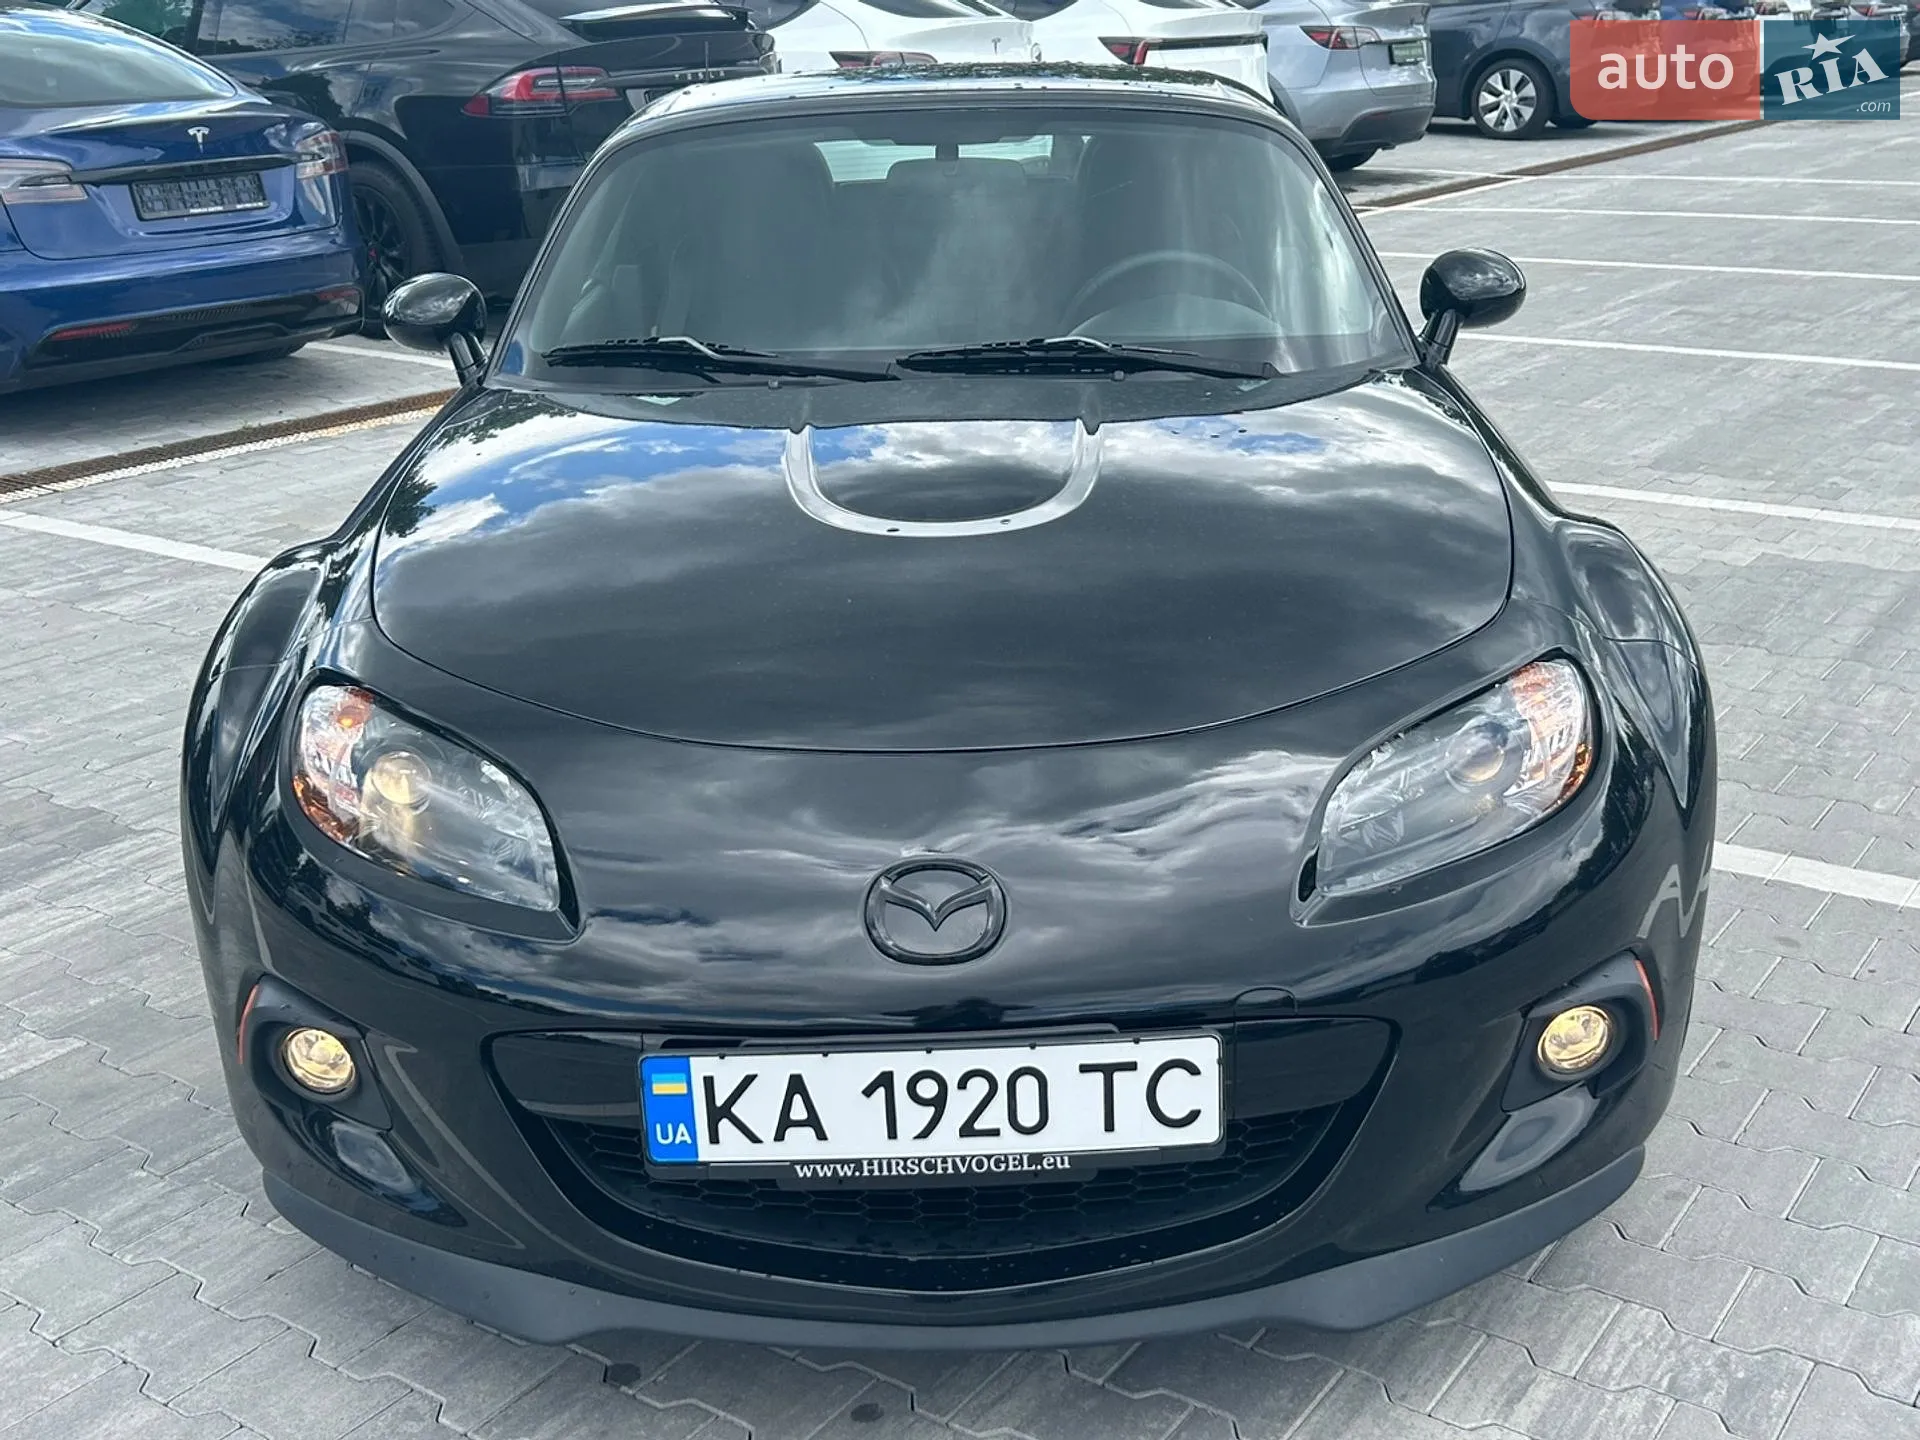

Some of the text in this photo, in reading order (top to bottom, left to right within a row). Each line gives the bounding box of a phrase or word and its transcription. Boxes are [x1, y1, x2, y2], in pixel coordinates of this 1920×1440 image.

[674, 70, 725, 81] TESLA
[702, 1057, 1203, 1145] KA 1920 TC
[656, 1122, 692, 1146] UA
[794, 1153, 1071, 1179] www.HIRSCHVOGEL.eu
